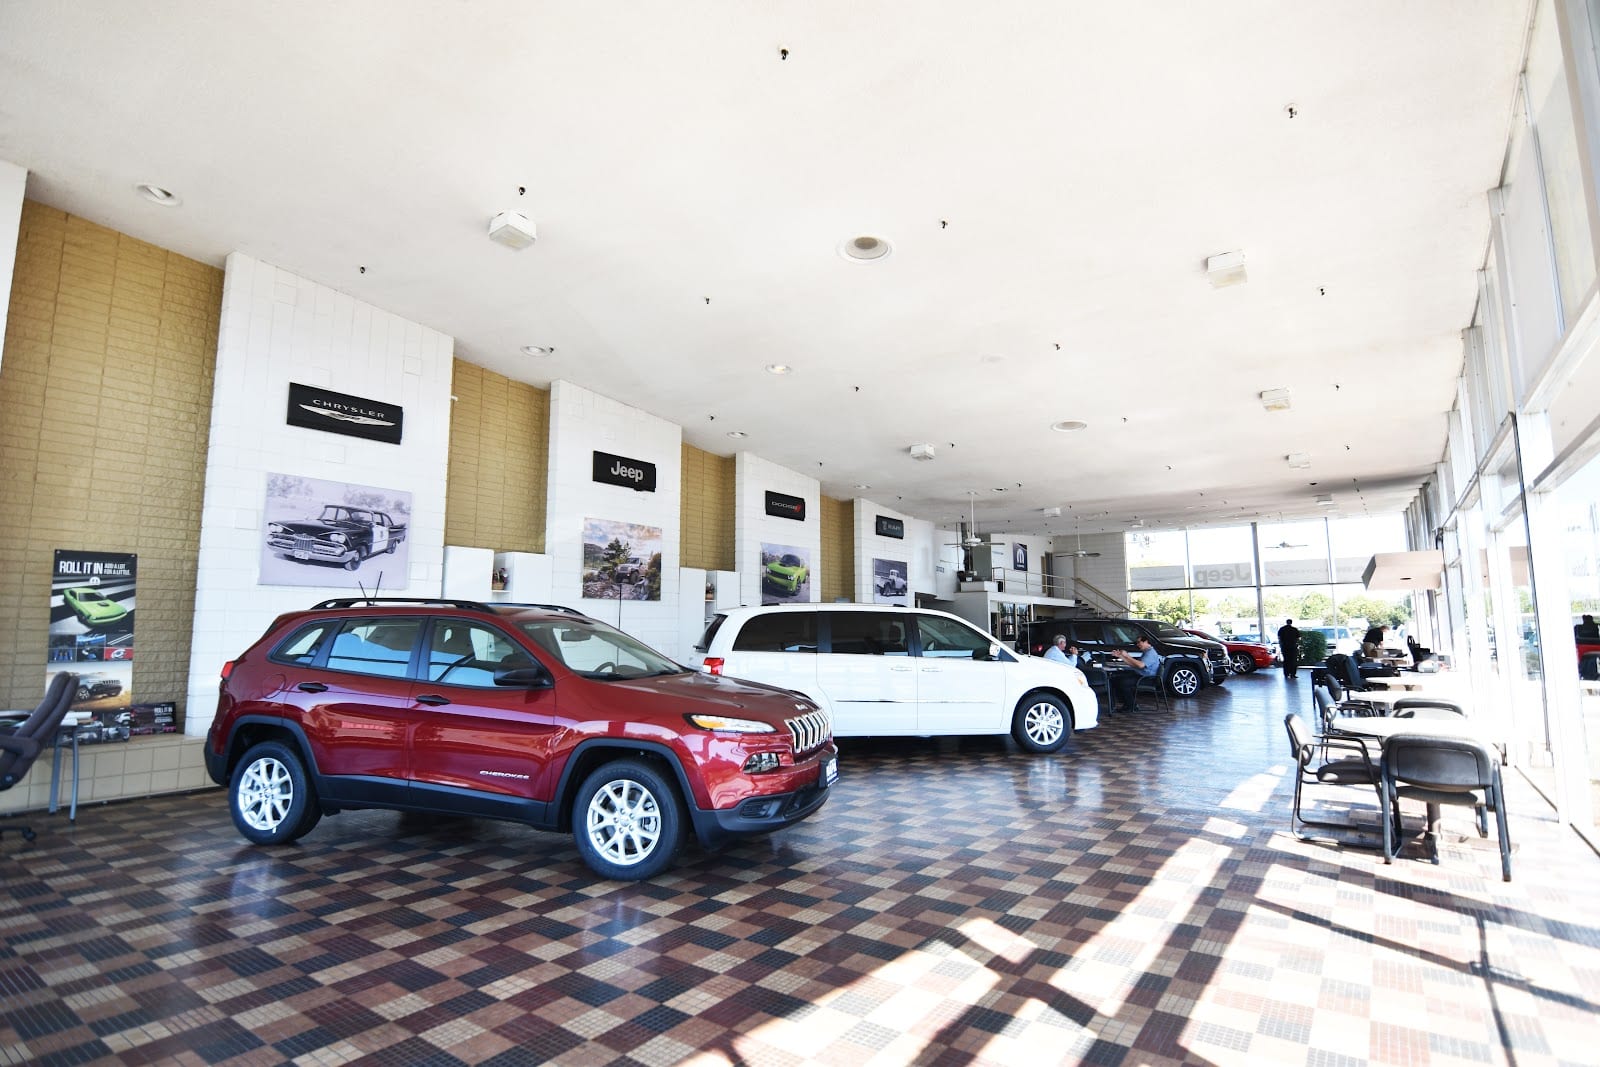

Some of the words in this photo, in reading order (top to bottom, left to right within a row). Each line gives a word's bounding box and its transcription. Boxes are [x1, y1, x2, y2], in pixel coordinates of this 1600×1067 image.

[312, 399, 385, 418] CHRYSLER
[610, 460, 644, 483] Jeep
[771, 501, 798, 510] DODGE
[59, 560, 82, 574] ROLL
[83, 561, 93, 575] IT
[93, 562, 103, 574] IN
[479, 770, 530, 780] CHEROKEE
